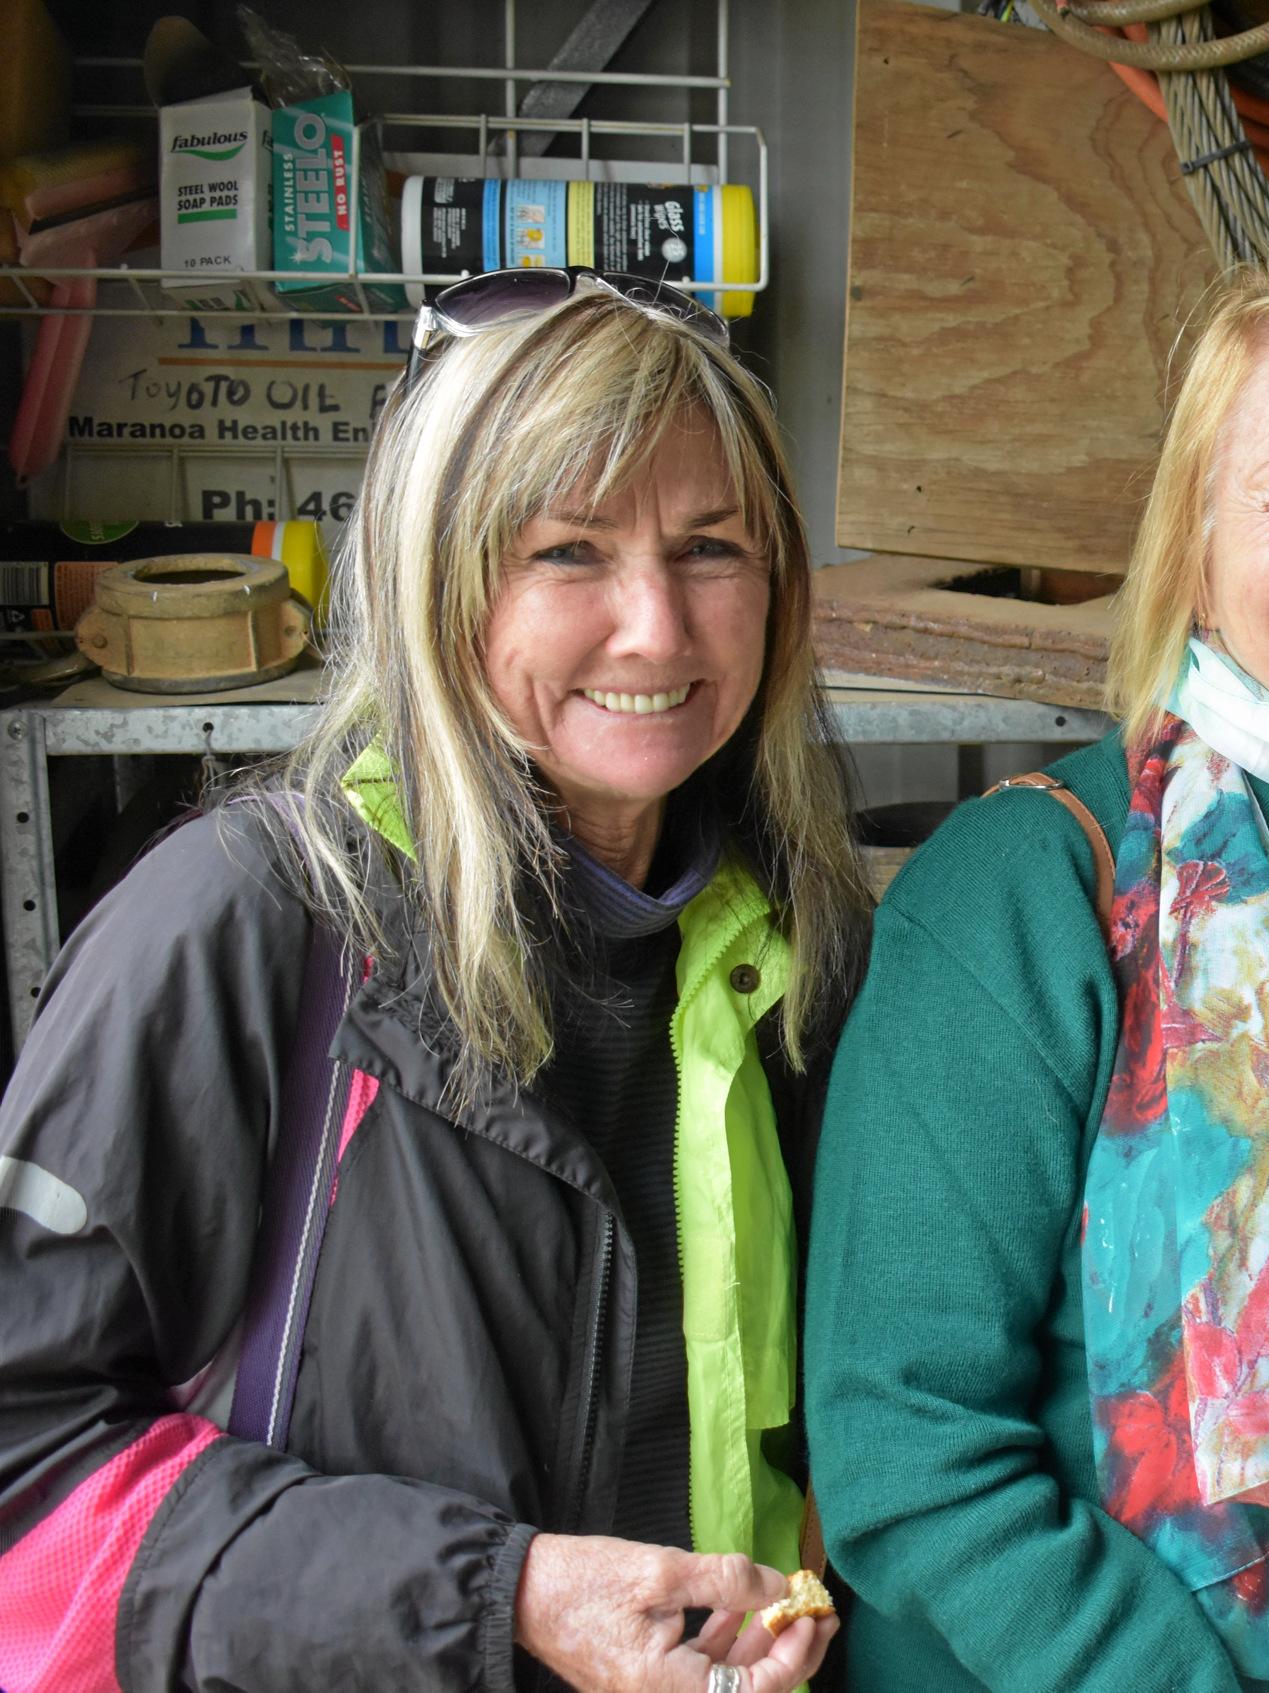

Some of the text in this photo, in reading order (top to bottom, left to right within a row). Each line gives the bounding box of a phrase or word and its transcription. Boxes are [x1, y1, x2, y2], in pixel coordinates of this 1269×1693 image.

[170, 130, 249, 153] fabulous
[177, 180, 239, 197] STEEL WOOL
[284, 152, 296, 232] STAINLESS
[294, 112, 334, 264] STEELO
[333, 149, 347, 216] NO RUST
[177, 193, 239, 211] SOAP PADS
[184, 255, 232, 268] 10 PACK
[266, 380, 342, 414] OIL
[68, 416, 376, 443] Maranoa Health En
[201, 489, 276, 521] Ph:
